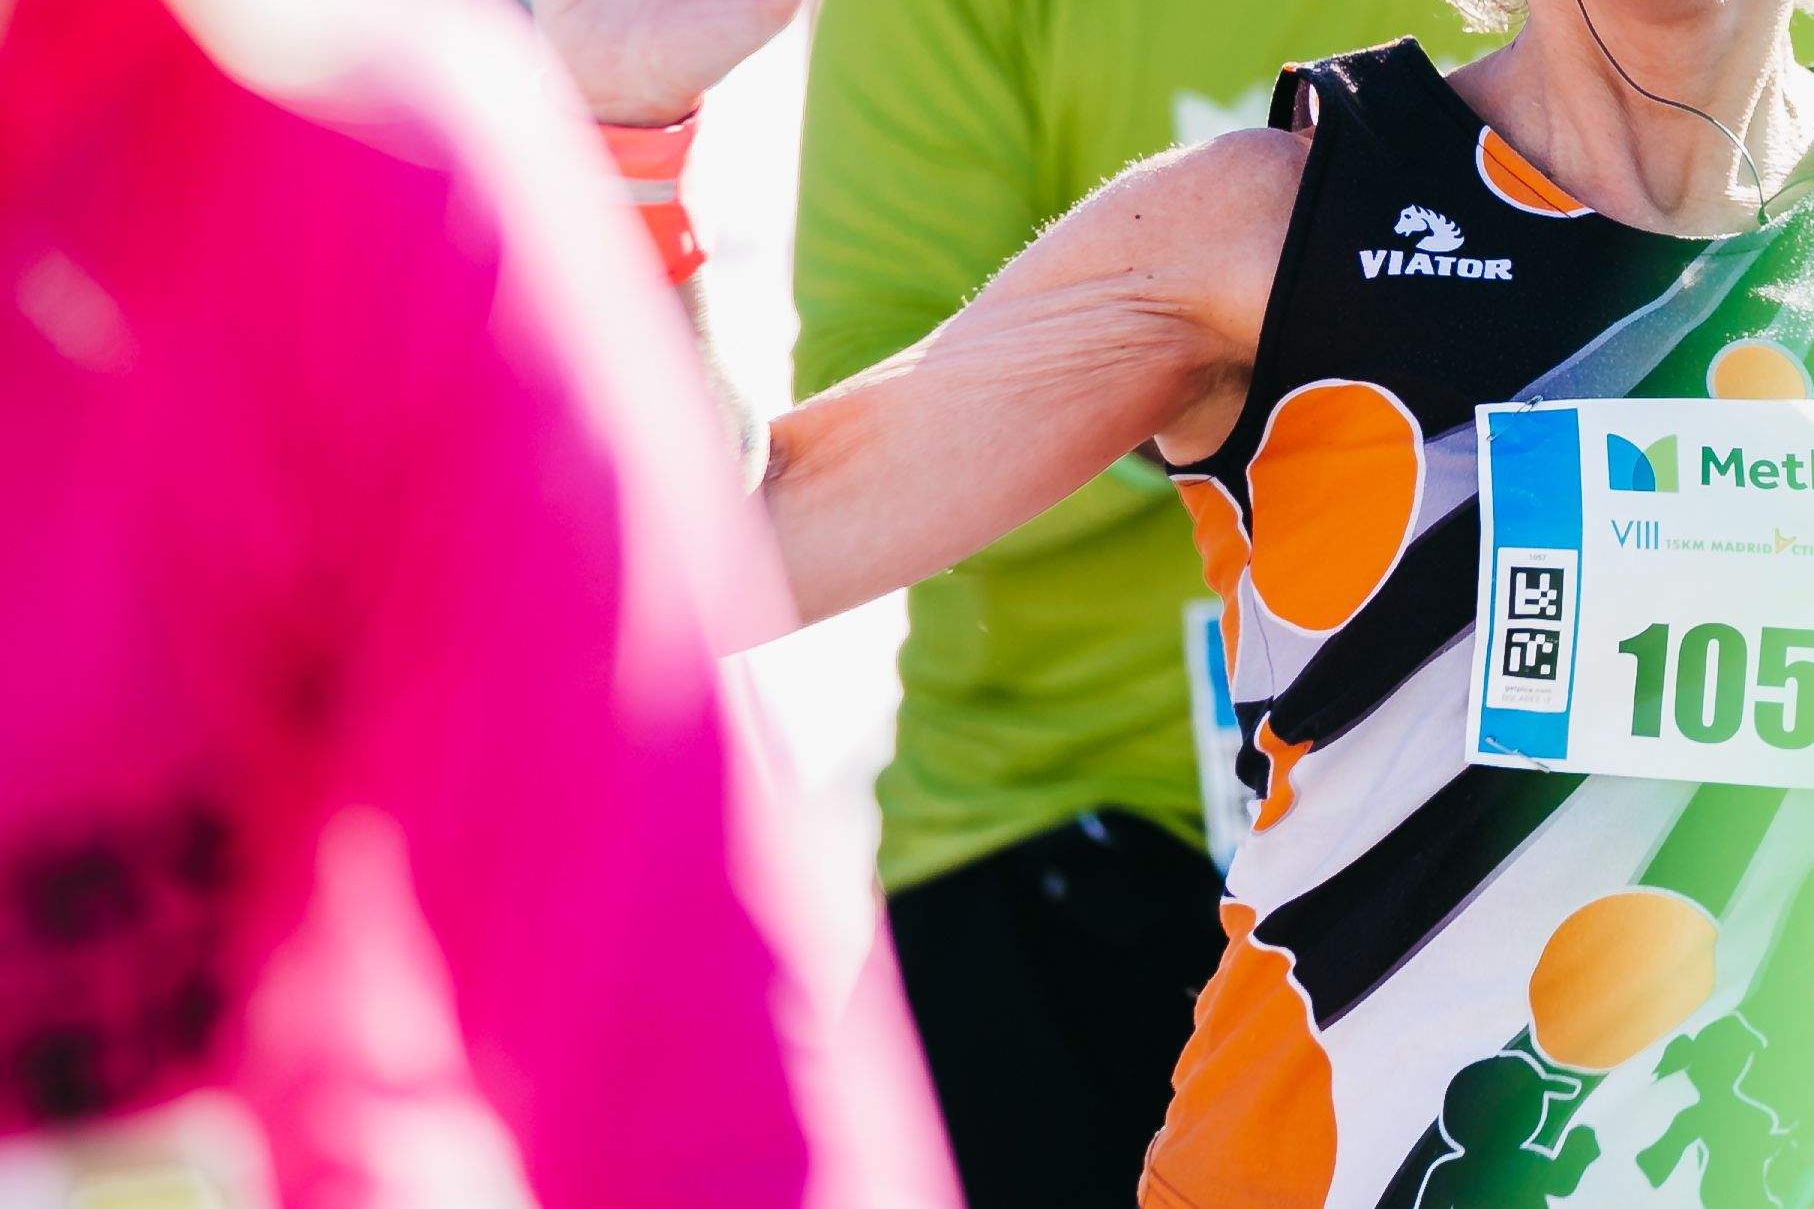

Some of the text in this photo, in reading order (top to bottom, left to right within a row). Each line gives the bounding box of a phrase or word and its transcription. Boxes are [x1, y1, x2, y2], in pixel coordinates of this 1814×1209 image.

[1359, 249, 1513, 280] VIATOR
[1611, 519, 1659, 550] VIII
[1665, 538, 1705, 552] 15KM
[1710, 540, 1773, 555] MADRID
